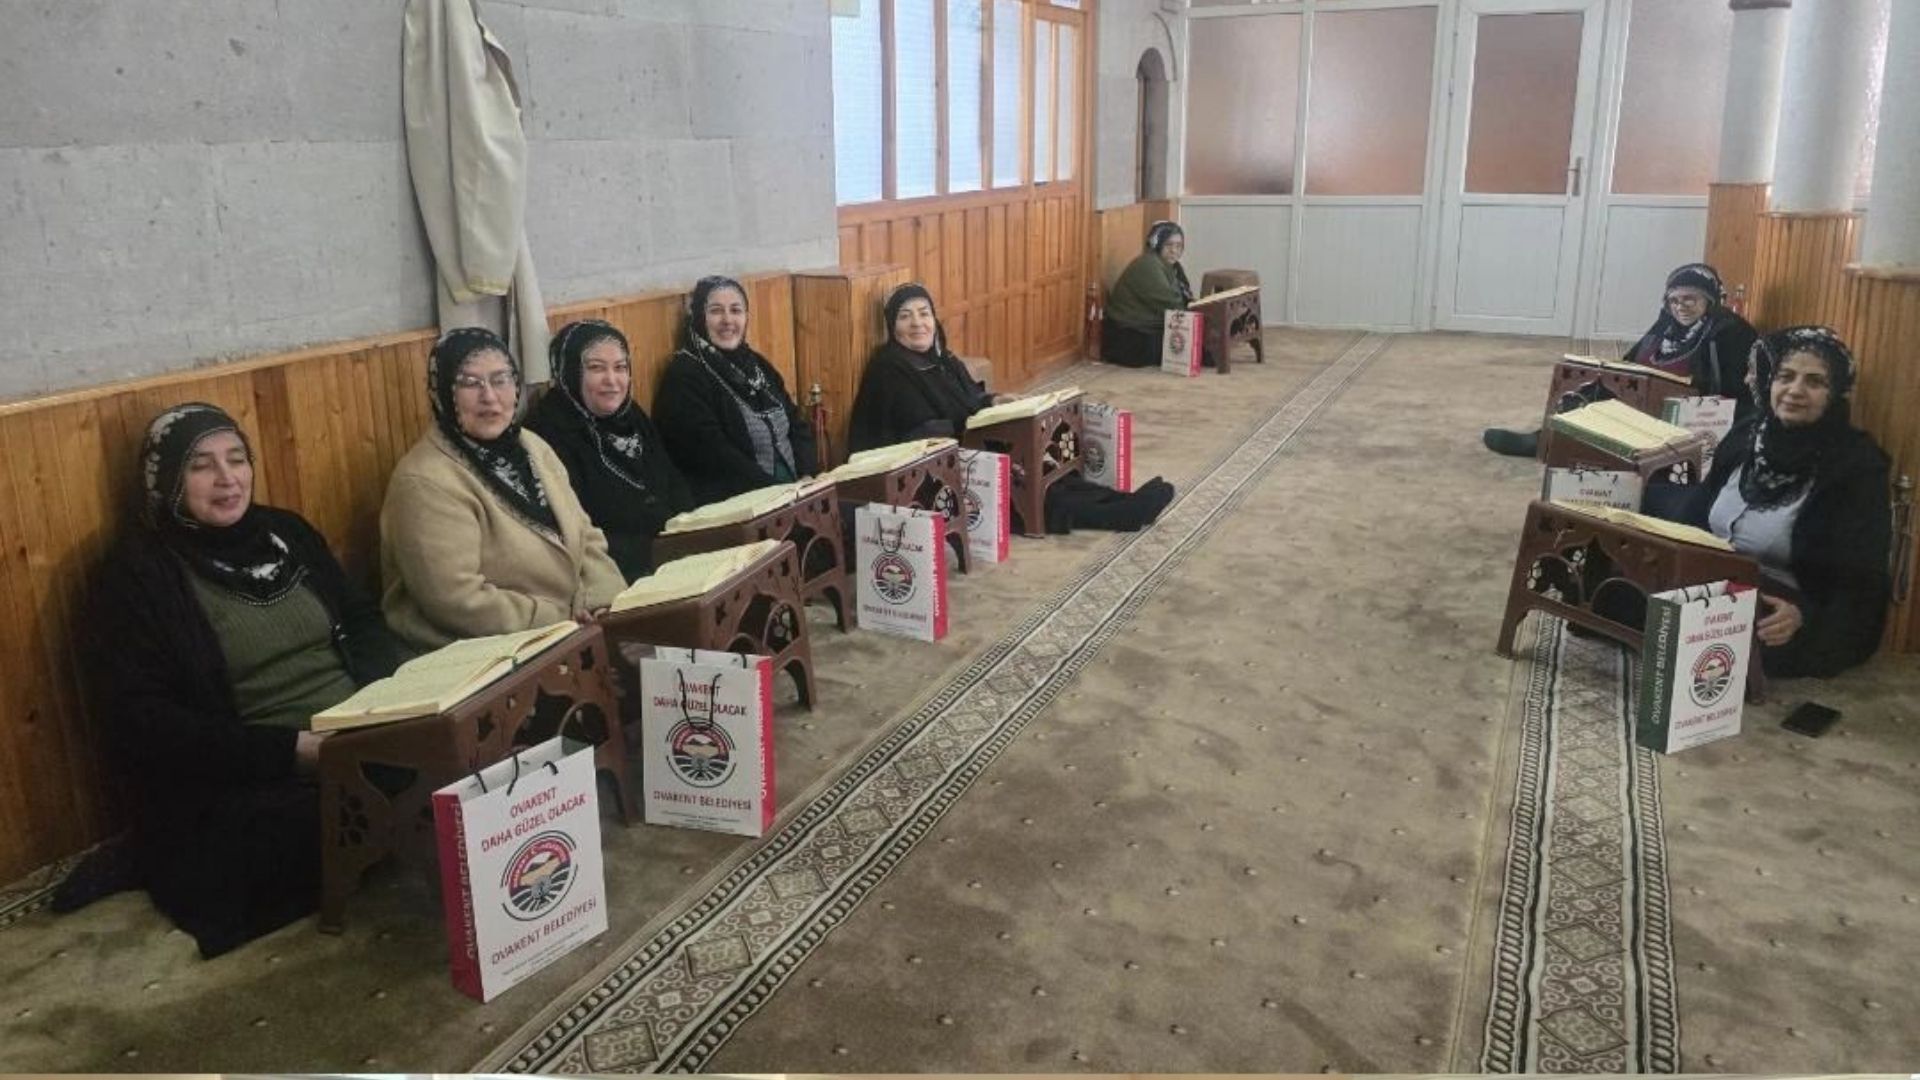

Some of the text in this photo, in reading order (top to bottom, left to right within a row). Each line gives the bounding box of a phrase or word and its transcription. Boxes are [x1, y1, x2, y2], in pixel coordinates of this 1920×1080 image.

[481, 793, 587, 852] DAHA GÜZEL OLACAK
[510, 786, 557, 818] OVAKENT
[491, 929, 542, 965] OVAKENT
[543, 898, 597, 937] BELEDİYESİ
